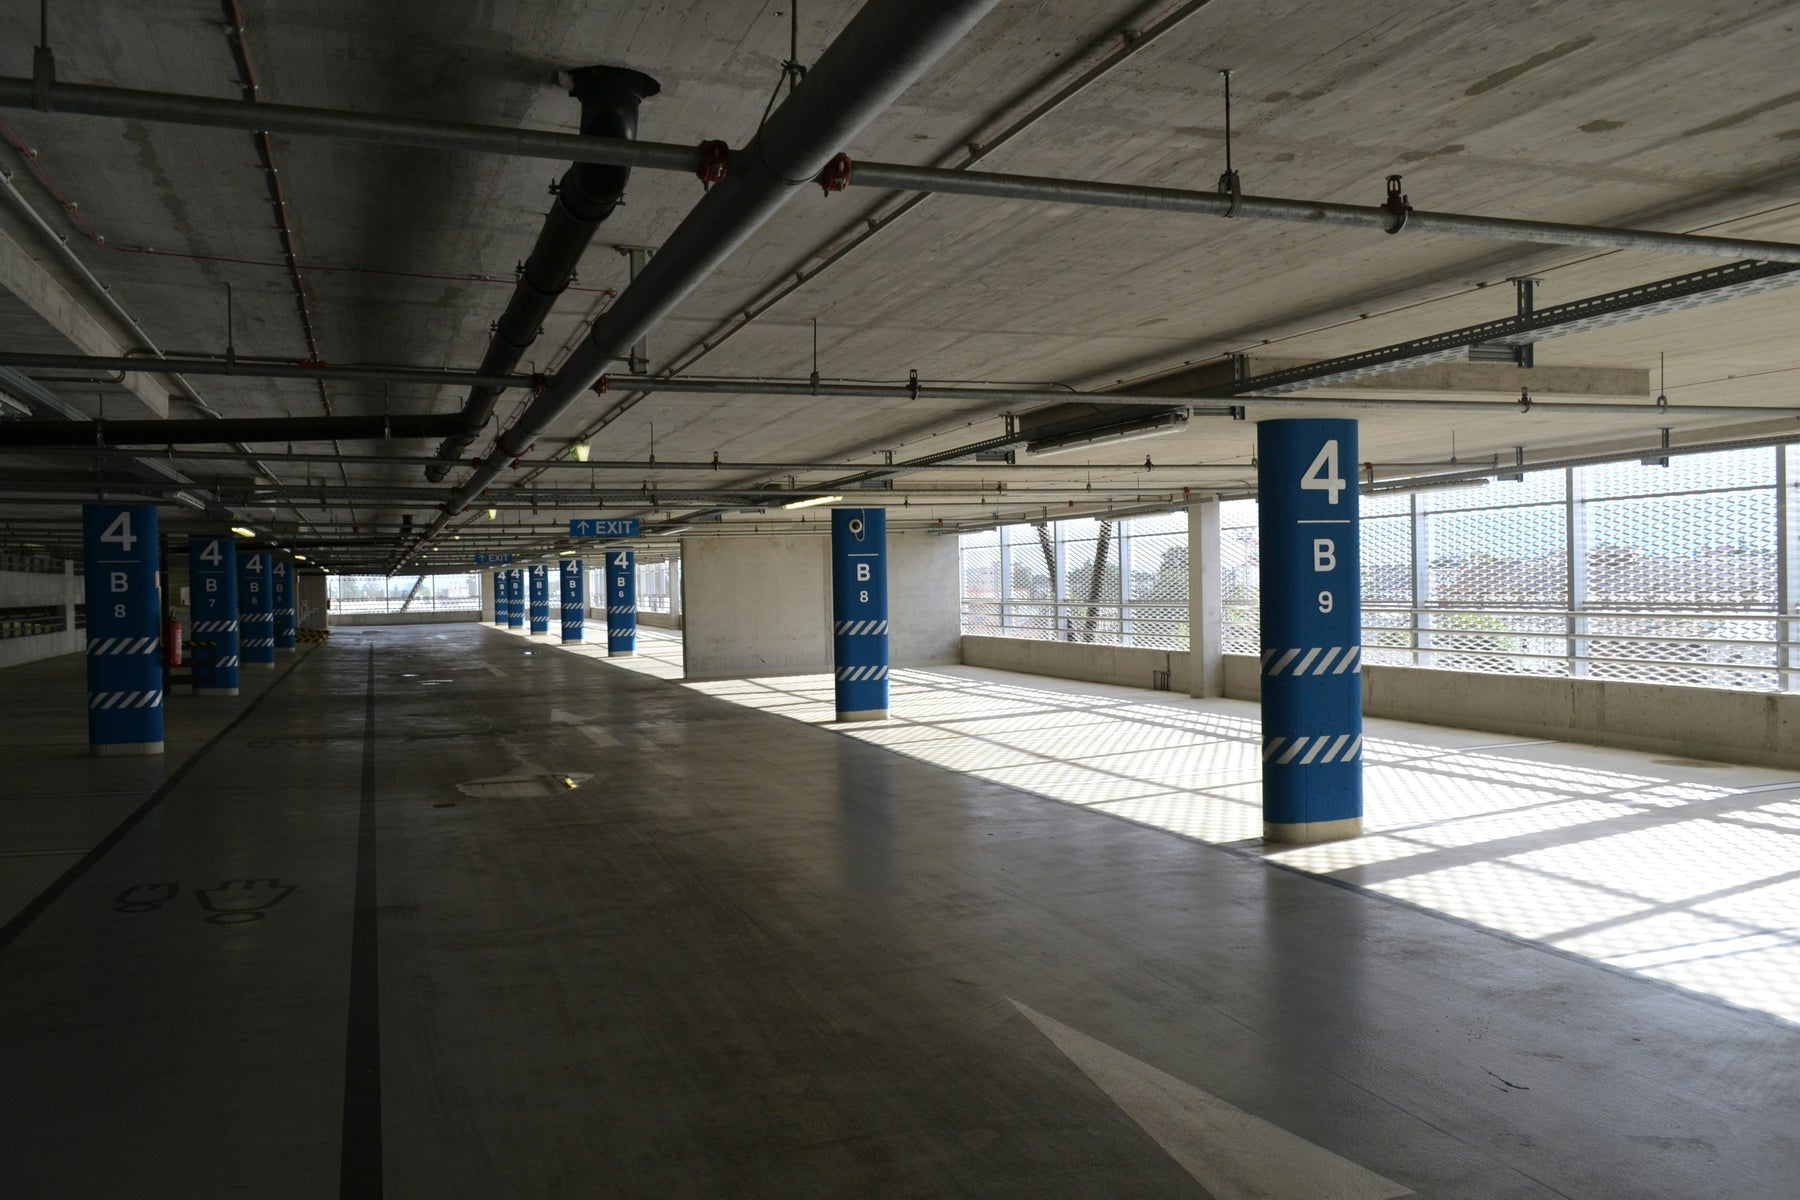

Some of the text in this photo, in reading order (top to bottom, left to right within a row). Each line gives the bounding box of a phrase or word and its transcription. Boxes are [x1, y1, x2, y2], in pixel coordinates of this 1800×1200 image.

[1300, 439, 1346, 505] 4
[100, 511, 137, 551] 4
[595, 520, 633, 535] EXIT
[199, 540, 223, 566] 4
[488, 554, 508, 562] EXIT
[614, 551, 629, 569] 4
[1313, 538, 1336, 572] B
[245, 554, 263, 574] 4
[272, 562, 287, 578] 4
[534, 565, 545, 577] 4
[566, 559, 579, 574] 4
[498, 571, 506, 581] 4
[511, 569, 521, 579] 4
[857, 563, 871, 582] B
[110, 572, 129, 593] B
[205, 578, 218, 592] B
[250, 582, 259, 593] B
[275, 583, 284, 593] B
[536, 581, 543, 589] B
[570, 580, 576, 589] B
[618, 577, 625, 587] B
[207, 598, 216, 609] 7
[860, 590, 869, 603] 8
[1318, 590, 1333, 614] 9
[114, 604, 126, 618] 8
